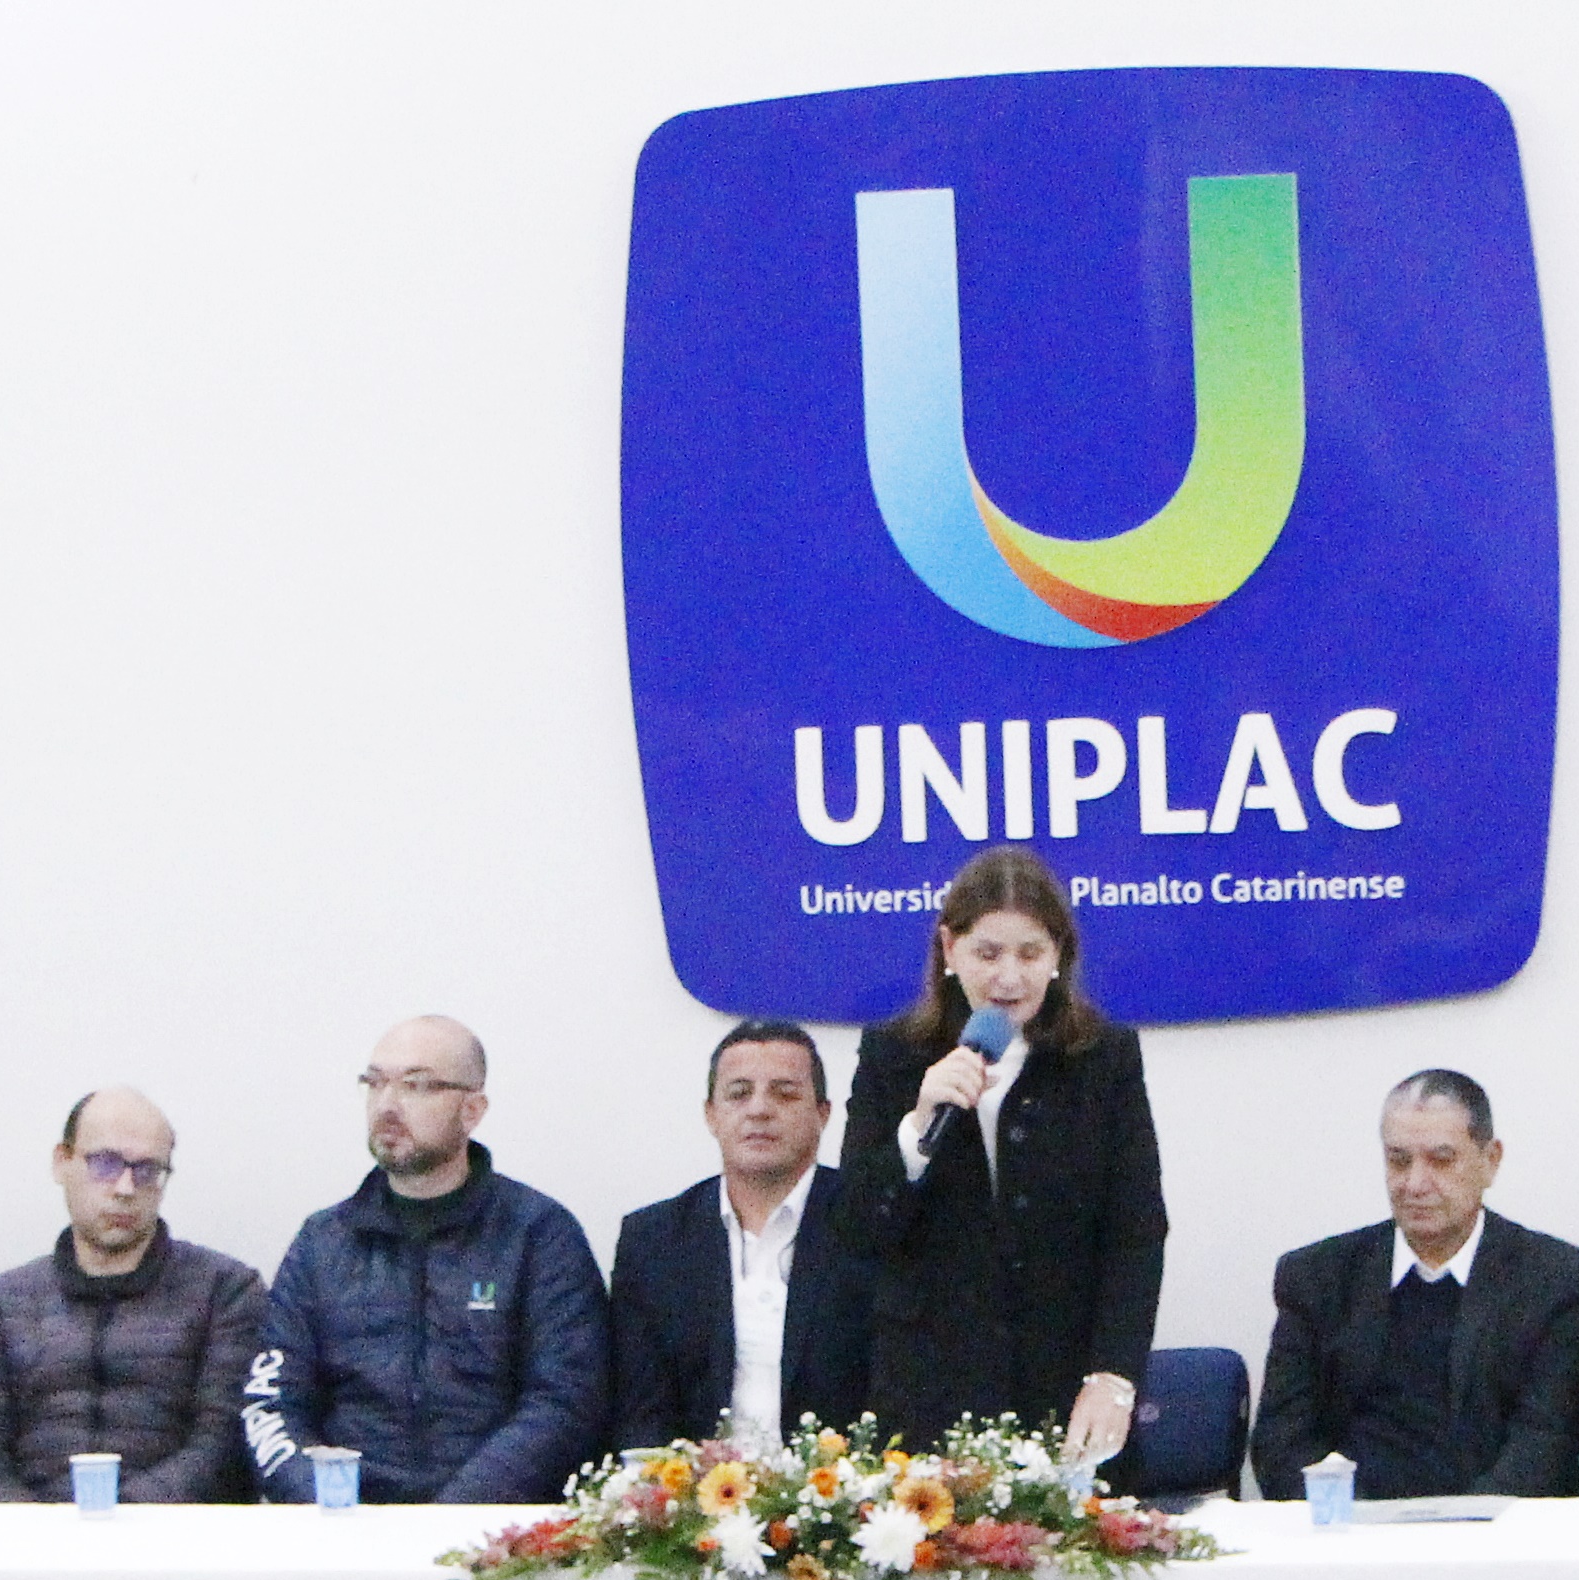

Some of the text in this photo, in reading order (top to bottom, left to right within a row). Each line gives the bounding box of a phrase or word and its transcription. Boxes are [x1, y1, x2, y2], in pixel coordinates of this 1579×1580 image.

[793, 707, 1403, 847] UNIPLAC
[799, 870, 1407, 916] Universid Planalto Catarinense
